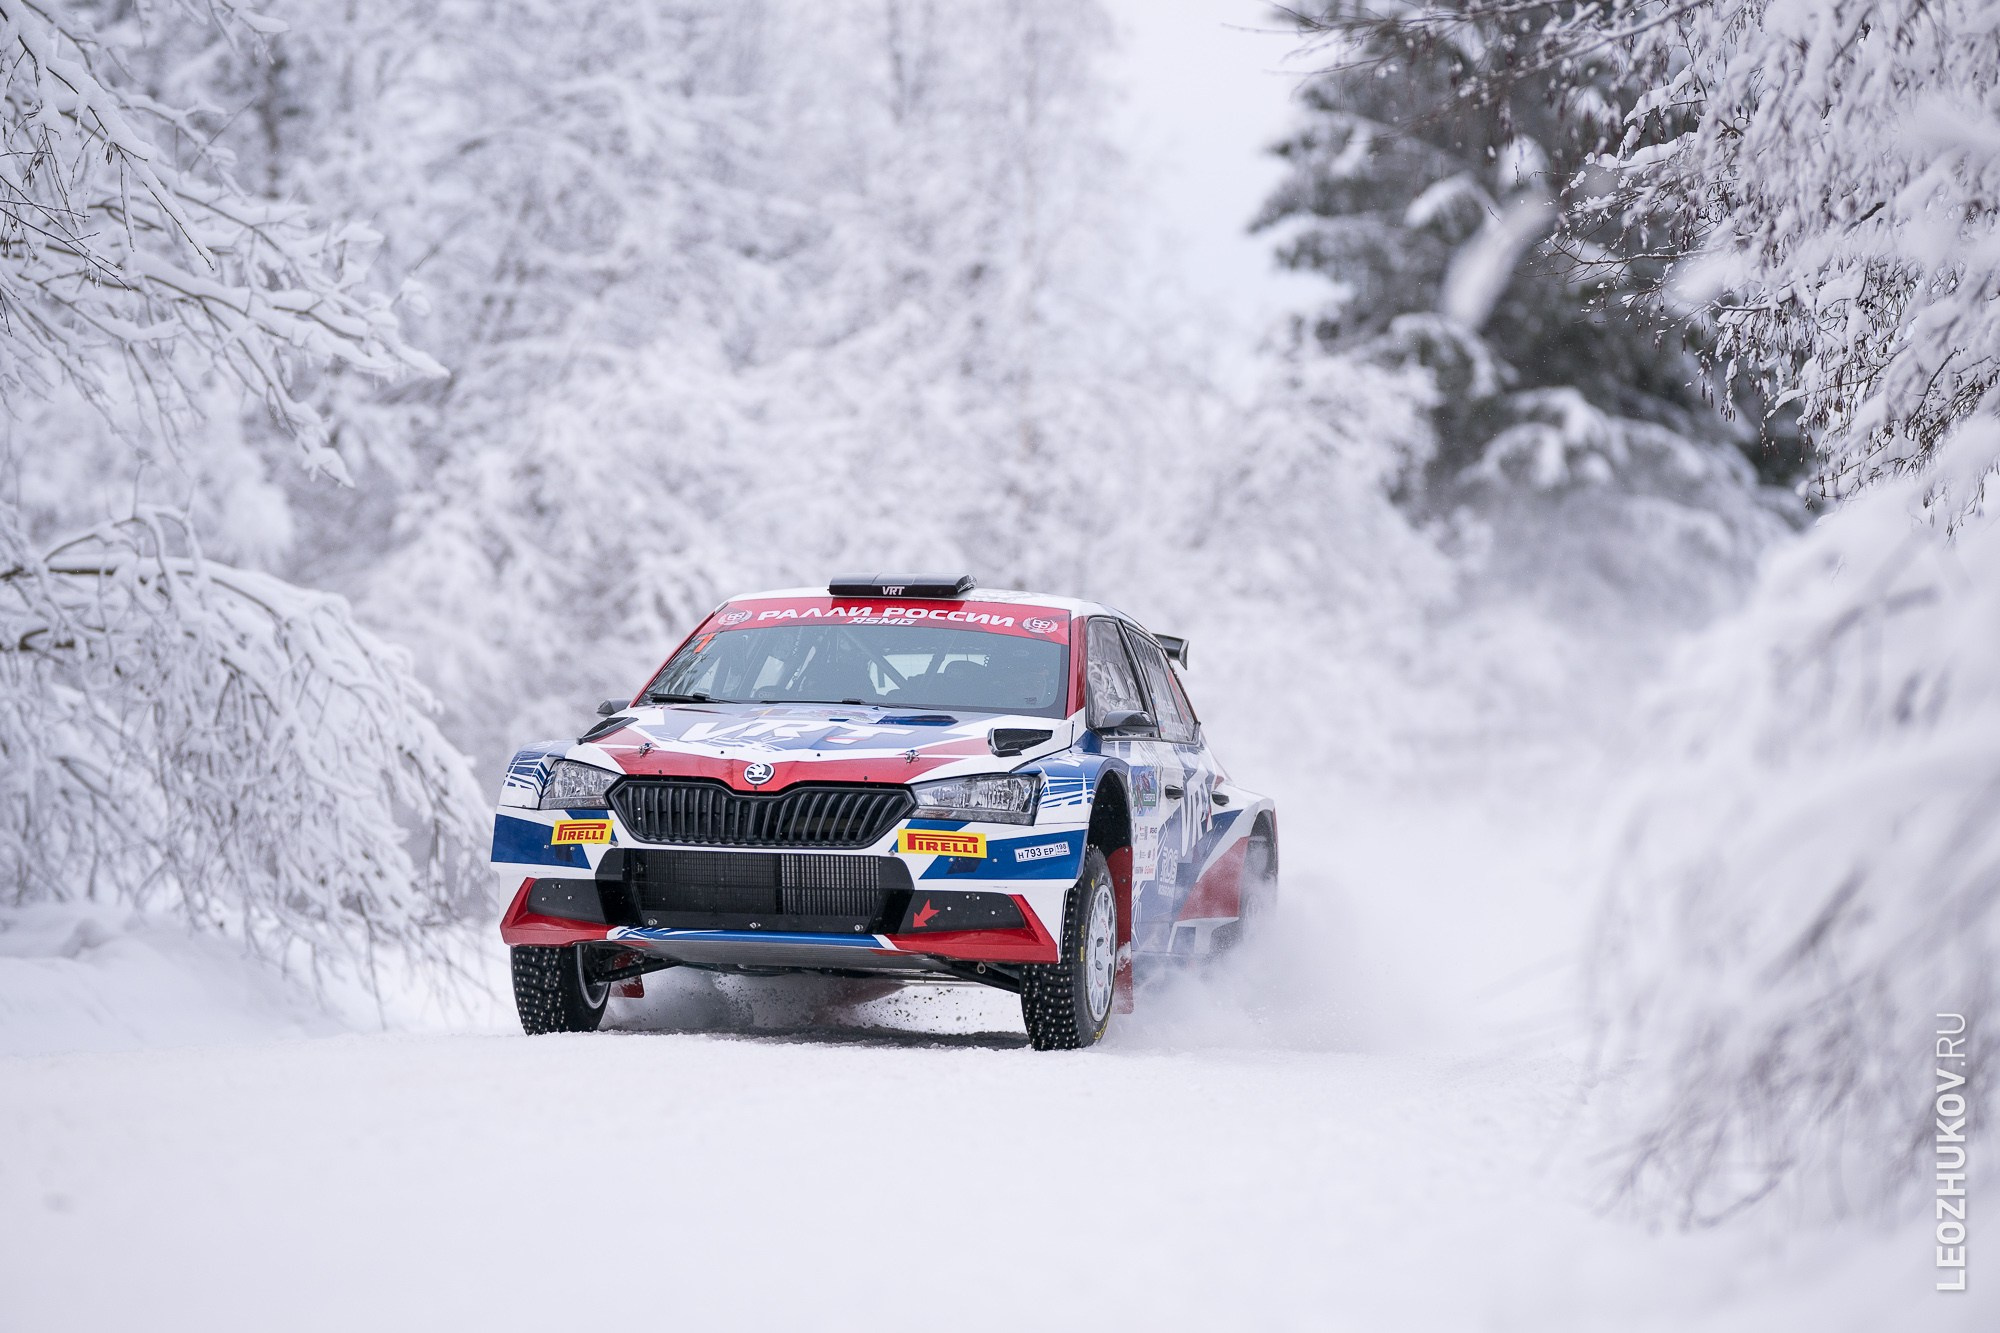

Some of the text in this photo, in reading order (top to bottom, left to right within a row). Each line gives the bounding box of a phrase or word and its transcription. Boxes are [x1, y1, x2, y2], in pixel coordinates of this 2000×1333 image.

[882, 586, 905, 595] VRT
[882, 607, 1015, 627] РОССИИ
[557, 823, 606, 841] PIRELLI
[907, 833, 979, 854] PIRELLI
